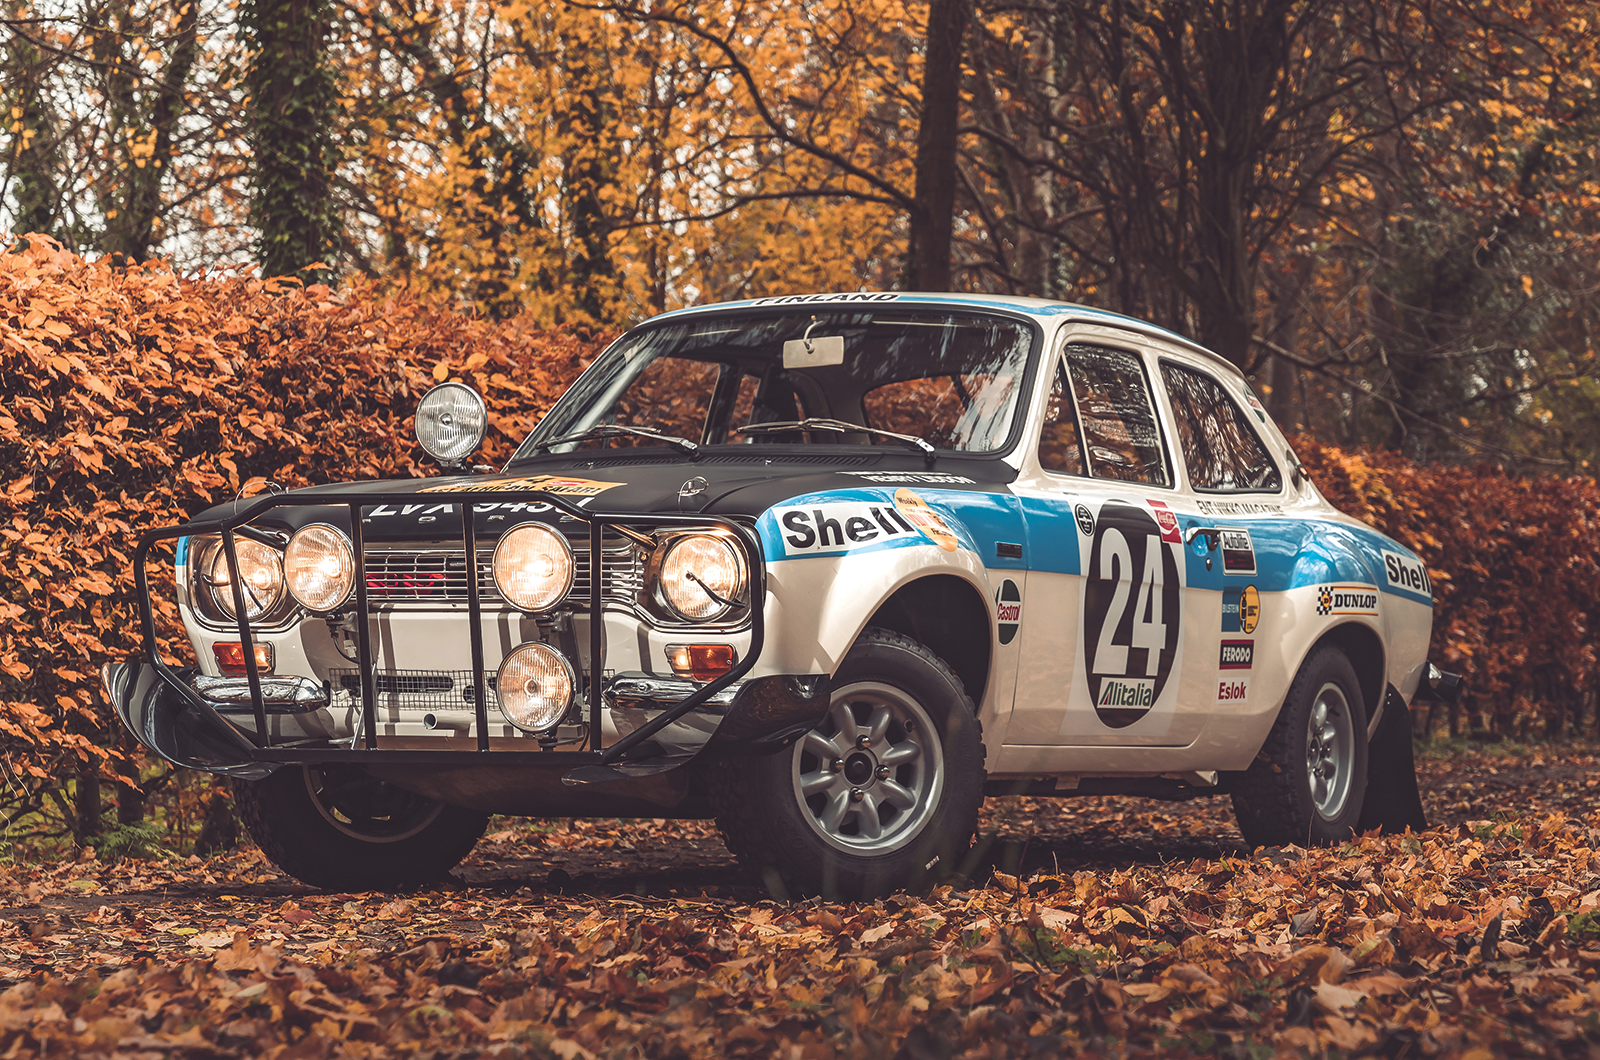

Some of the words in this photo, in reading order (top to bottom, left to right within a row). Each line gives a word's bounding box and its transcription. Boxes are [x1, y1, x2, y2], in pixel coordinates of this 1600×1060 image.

[755, 294, 899, 305] FINLAND
[782, 507, 916, 549] Shell
[1385, 554, 1431, 593] Shell
[1092, 527, 1167, 676] 24
[1334, 593, 1377, 609] DUNLOP
[996, 602, 1021, 621] Castrol
[1222, 646, 1251, 662] FERODO
[1099, 681, 1152, 707] Alitalia
[1218, 681, 1247, 700] Eslok
